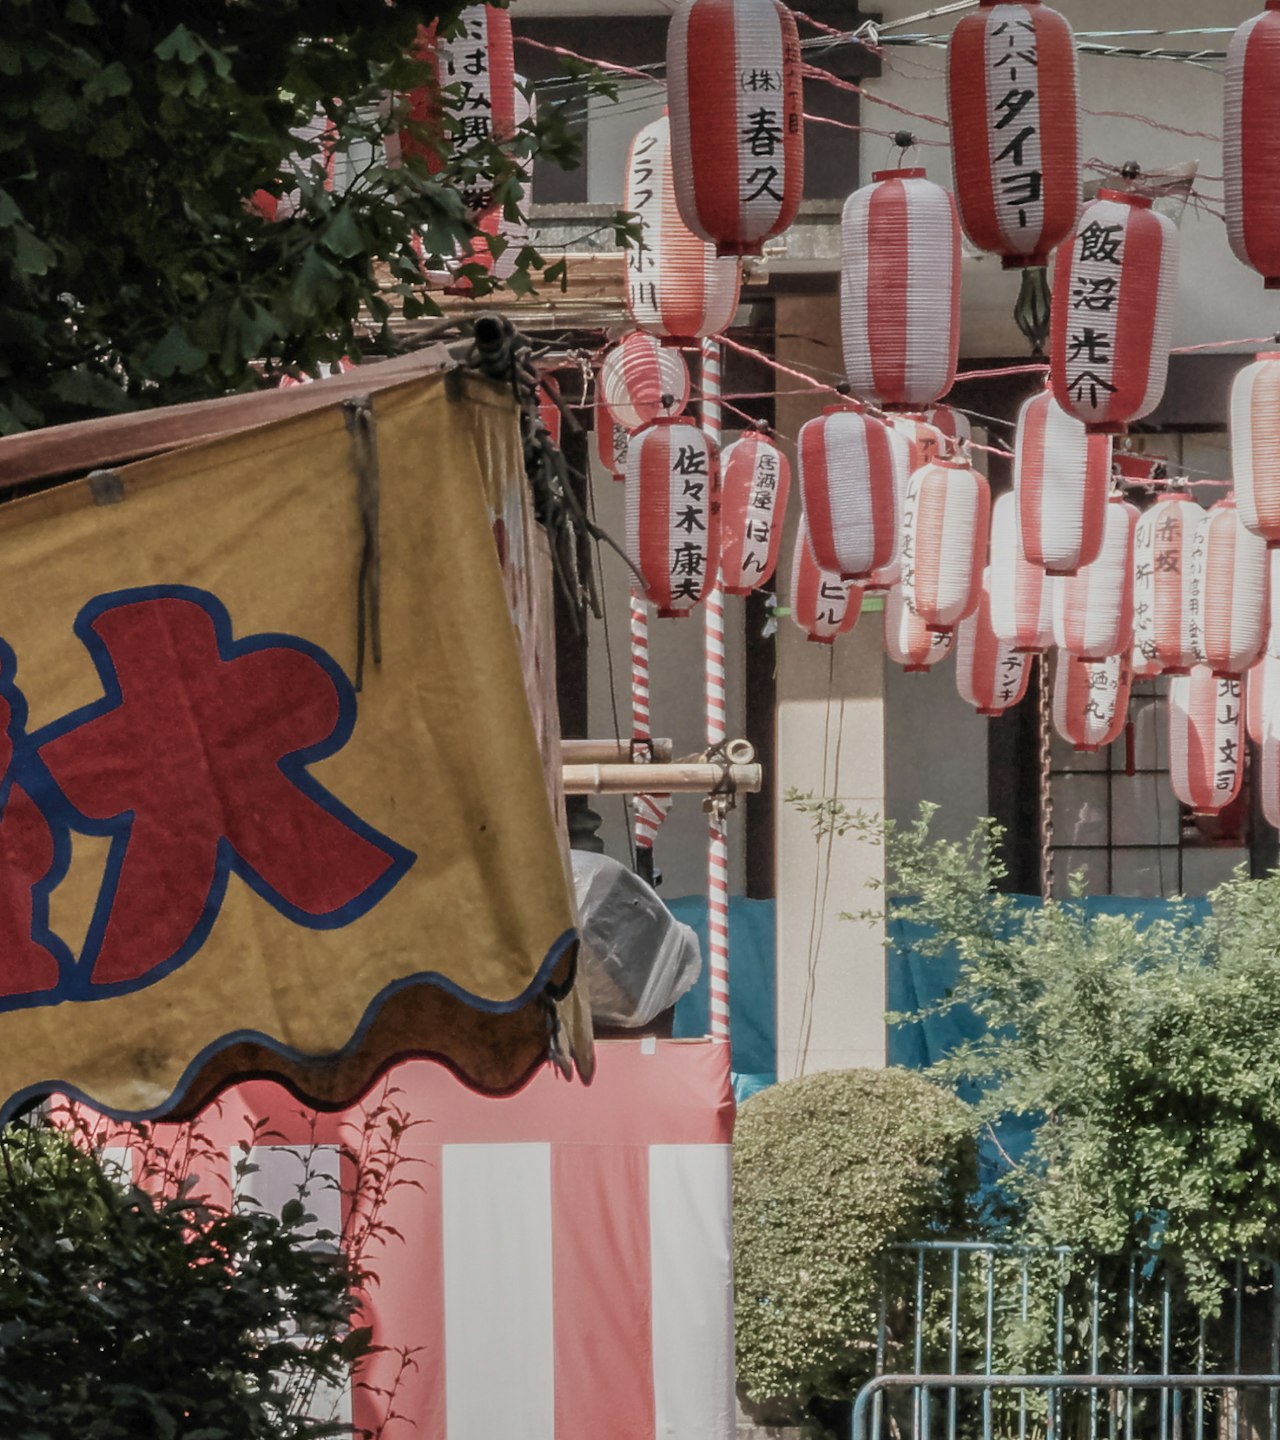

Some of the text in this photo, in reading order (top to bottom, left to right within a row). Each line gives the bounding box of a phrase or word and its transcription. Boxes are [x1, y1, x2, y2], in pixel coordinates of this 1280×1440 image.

[1065, 219, 1125, 409] 飯沼光介
[671, 445, 708, 602] 佐々木康夫
[1155, 517, 1181, 574] 赤坂
[1215, 679, 1241, 793] 北山文司
